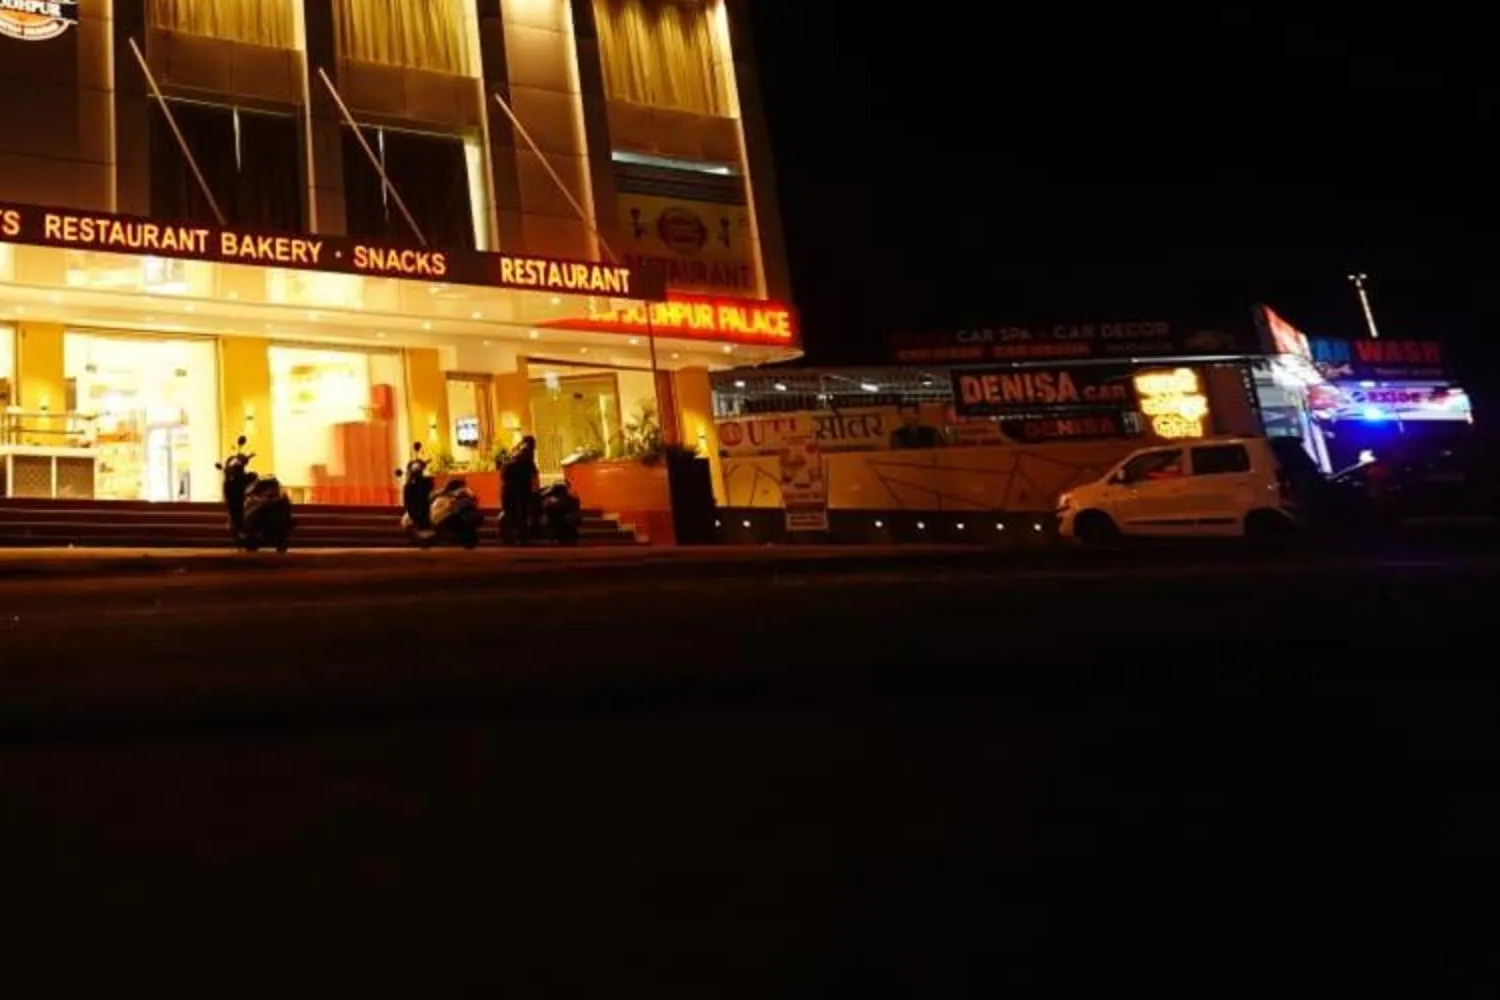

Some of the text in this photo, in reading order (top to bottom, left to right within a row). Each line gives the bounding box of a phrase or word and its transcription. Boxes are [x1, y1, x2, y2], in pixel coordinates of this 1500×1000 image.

[44, 203, 209, 253] RESTAURANT
[220, 231, 323, 264] BAKERY
[353, 244, 446, 276] SNACKS
[499, 257, 631, 294] RESTAURANT
[717, 306, 792, 338] PALACE
[1355, 336, 1442, 364] WASH
[958, 370, 1081, 406] DENISA
